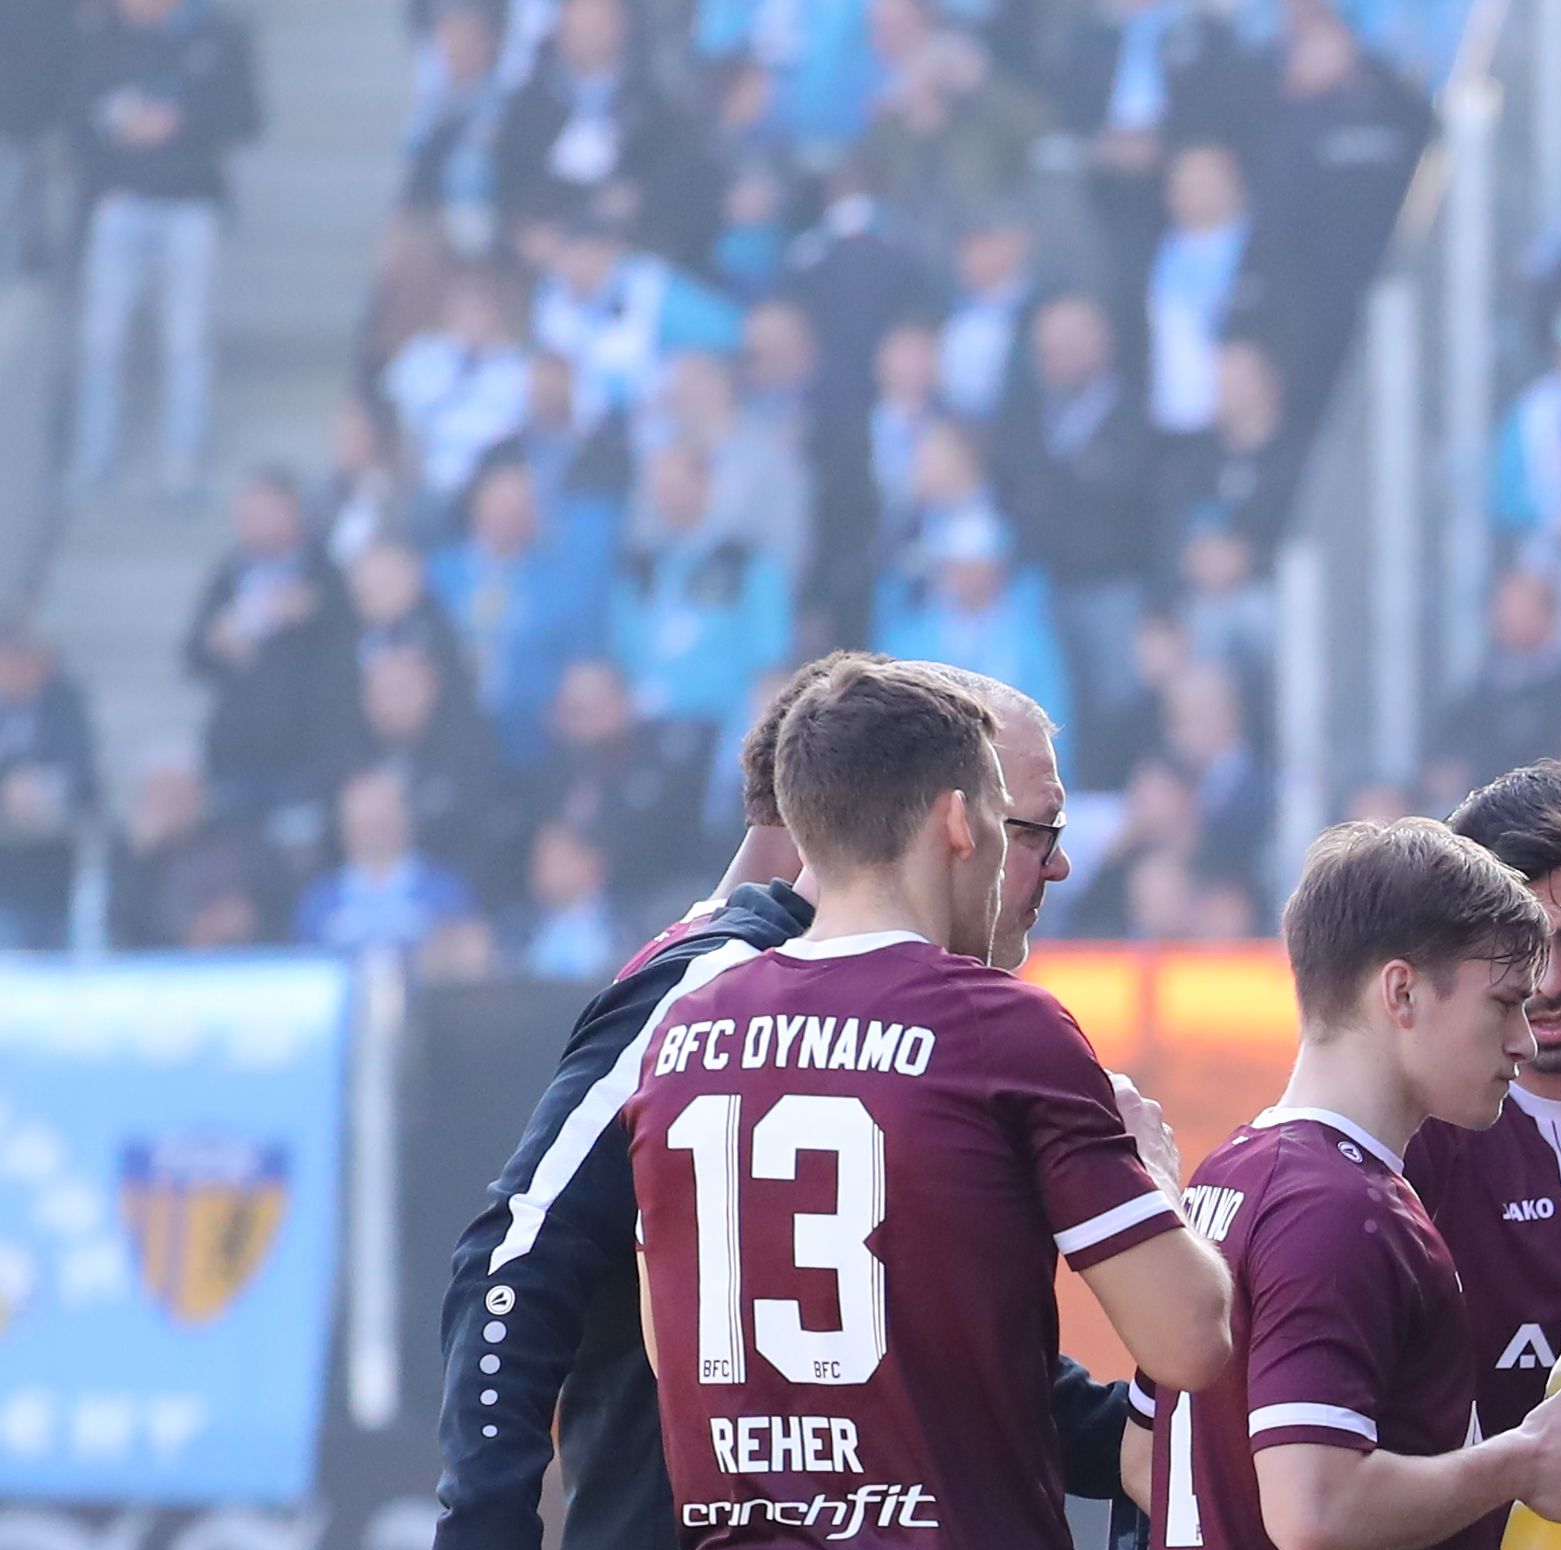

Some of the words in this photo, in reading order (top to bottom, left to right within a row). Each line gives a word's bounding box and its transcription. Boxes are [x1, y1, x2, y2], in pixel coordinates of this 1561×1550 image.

[655, 1021, 735, 1076] BFC
[741, 1014, 935, 1076] DYNAMO
[666, 1094, 886, 1385] 13
[703, 1360, 731, 1379] BFC
[813, 1360, 842, 1380] BFC
[710, 1416, 864, 1474] REHER
